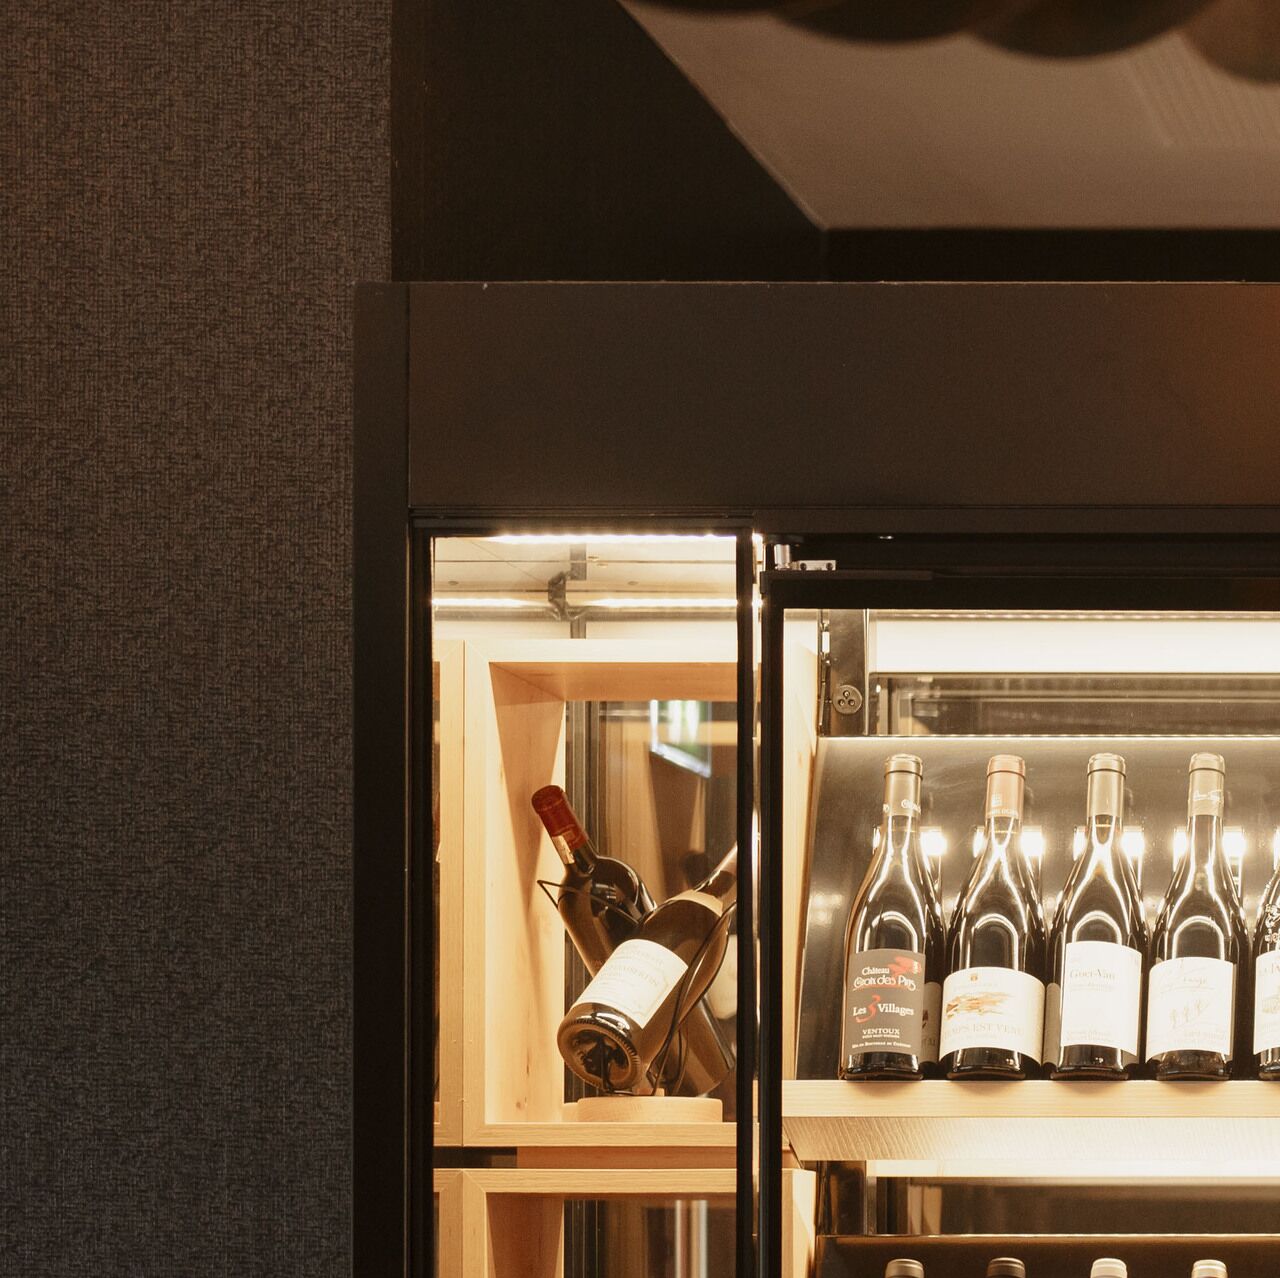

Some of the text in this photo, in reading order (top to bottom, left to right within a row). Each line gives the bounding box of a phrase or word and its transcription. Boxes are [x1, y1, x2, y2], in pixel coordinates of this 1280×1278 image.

[853, 1007, 867, 1017] Les
[878, 1003, 914, 1017] Villages
[862, 1028, 901, 1036] VENTOUX
